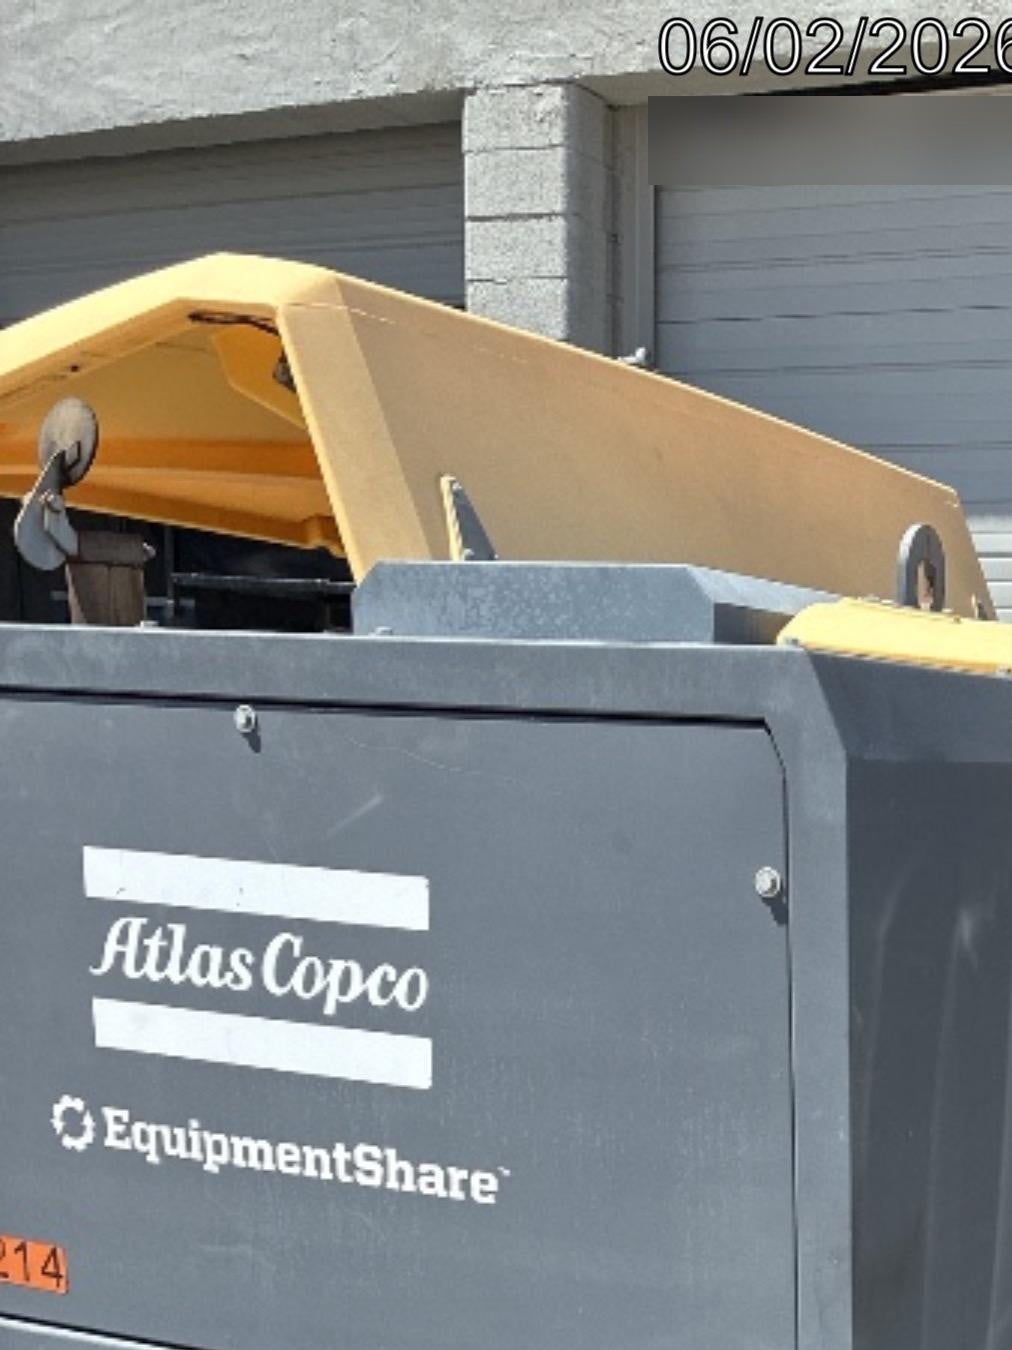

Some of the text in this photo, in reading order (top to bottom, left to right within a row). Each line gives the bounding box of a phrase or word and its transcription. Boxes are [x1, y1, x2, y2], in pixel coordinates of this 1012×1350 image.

[90, 917, 429, 1015] Atlas Copco
[102, 1106, 499, 1205] EquipmentShare
